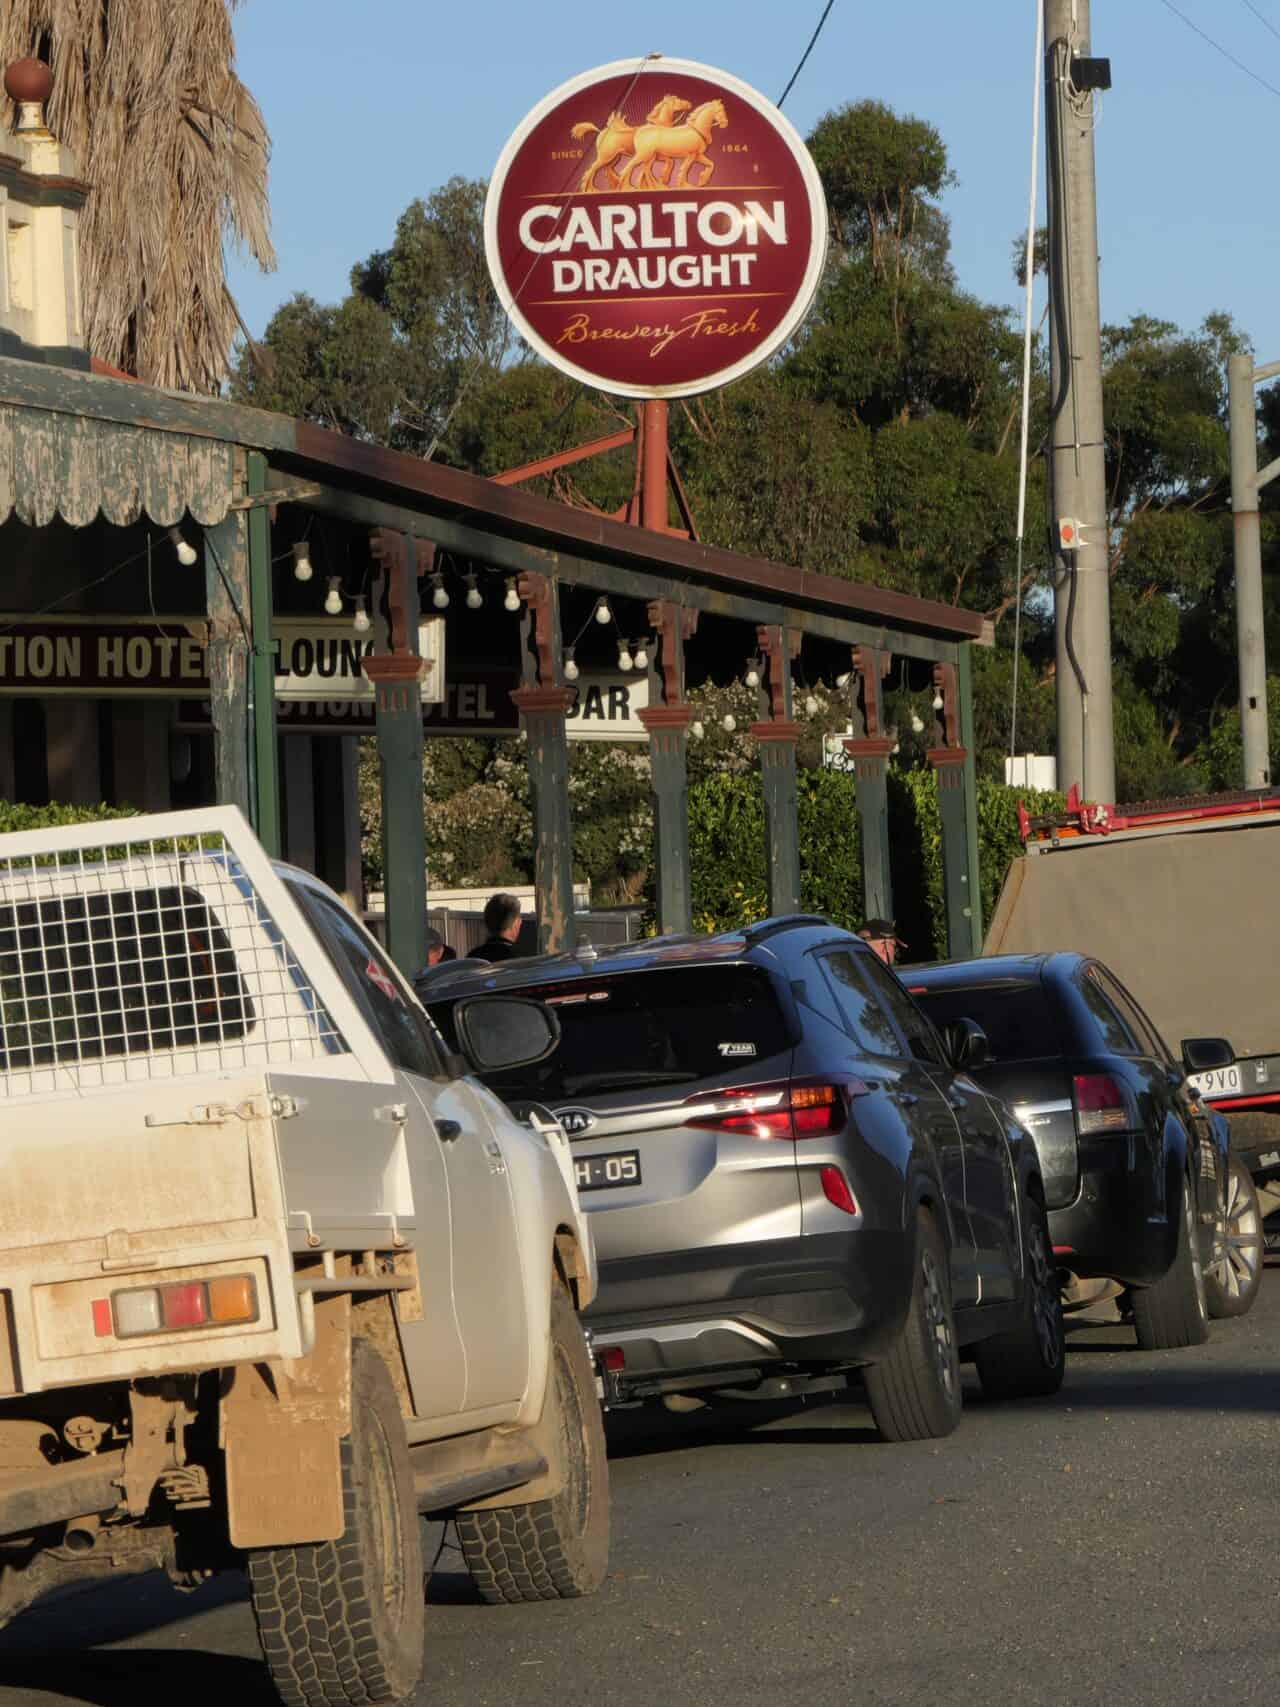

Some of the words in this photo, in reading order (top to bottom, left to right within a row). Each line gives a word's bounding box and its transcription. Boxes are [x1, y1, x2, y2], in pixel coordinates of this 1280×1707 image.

[551, 150, 584, 161] SINCE
[518, 200, 788, 254] CARLTON
[552, 253, 757, 293] DRAUGHT
[556, 313, 684, 358] Brewery
[681, 308, 761, 338] Fresh
[274, 638, 375, 678] LOUN
